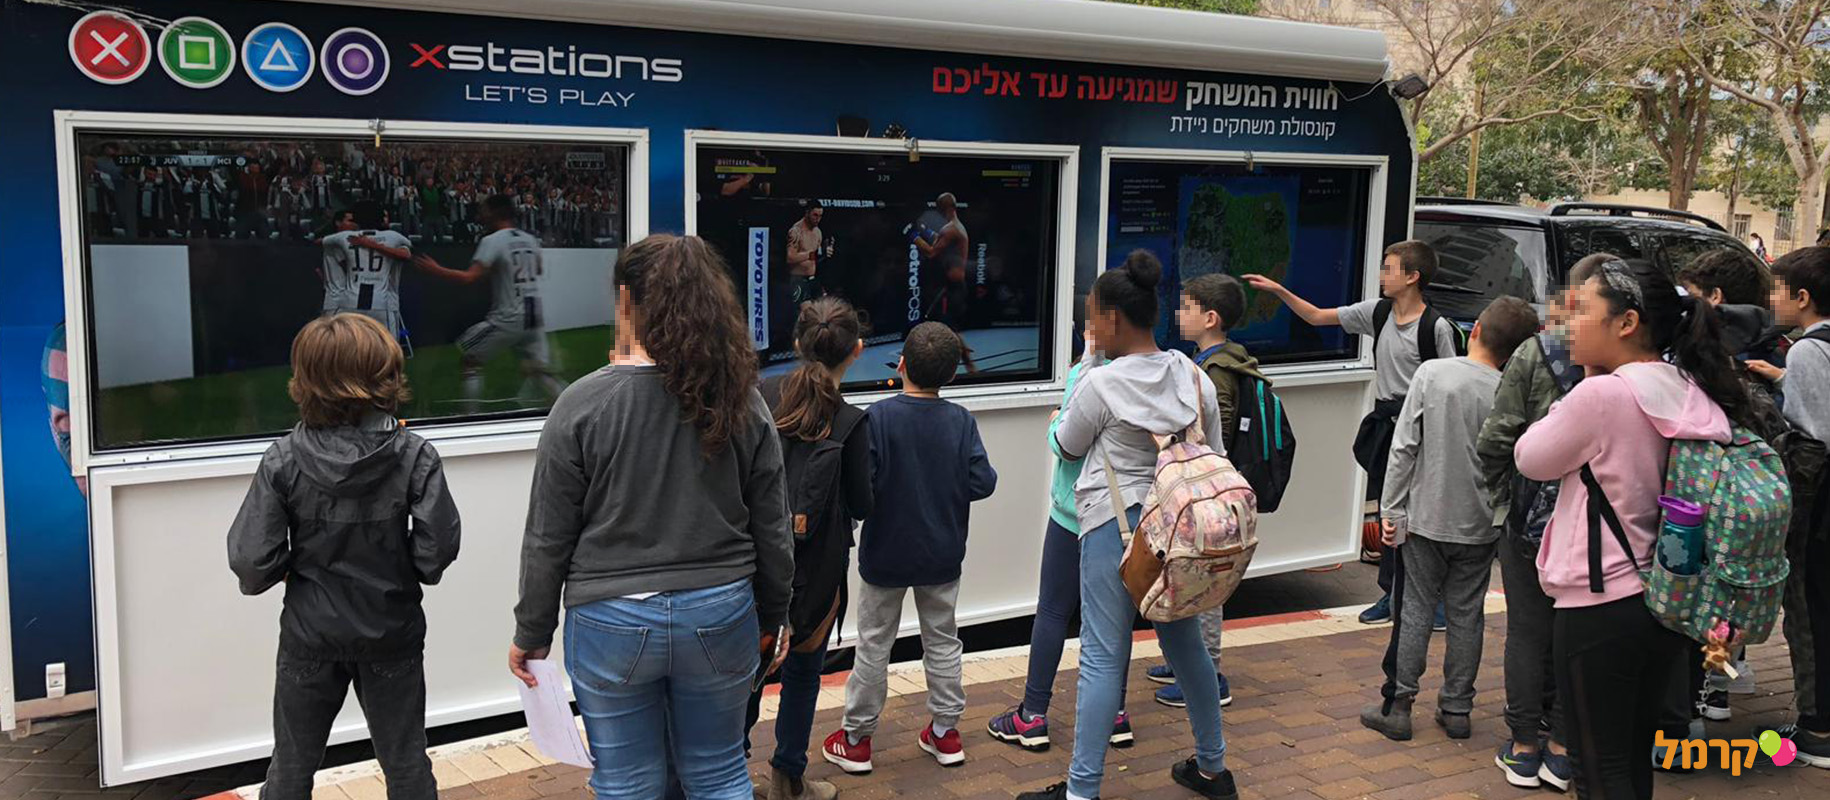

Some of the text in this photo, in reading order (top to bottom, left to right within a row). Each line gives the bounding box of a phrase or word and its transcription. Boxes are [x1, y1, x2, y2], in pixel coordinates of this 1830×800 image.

[465, 84, 635, 107] LET'S PLAY
[932, 62, 1338, 111] חווית המשחק שמגיעה עד אליכם
[1169, 115, 1336, 141] קונסולת משחקים ניידת
[348, 245, 384, 272] 16
[754, 231, 764, 342] TOYO TIRES
